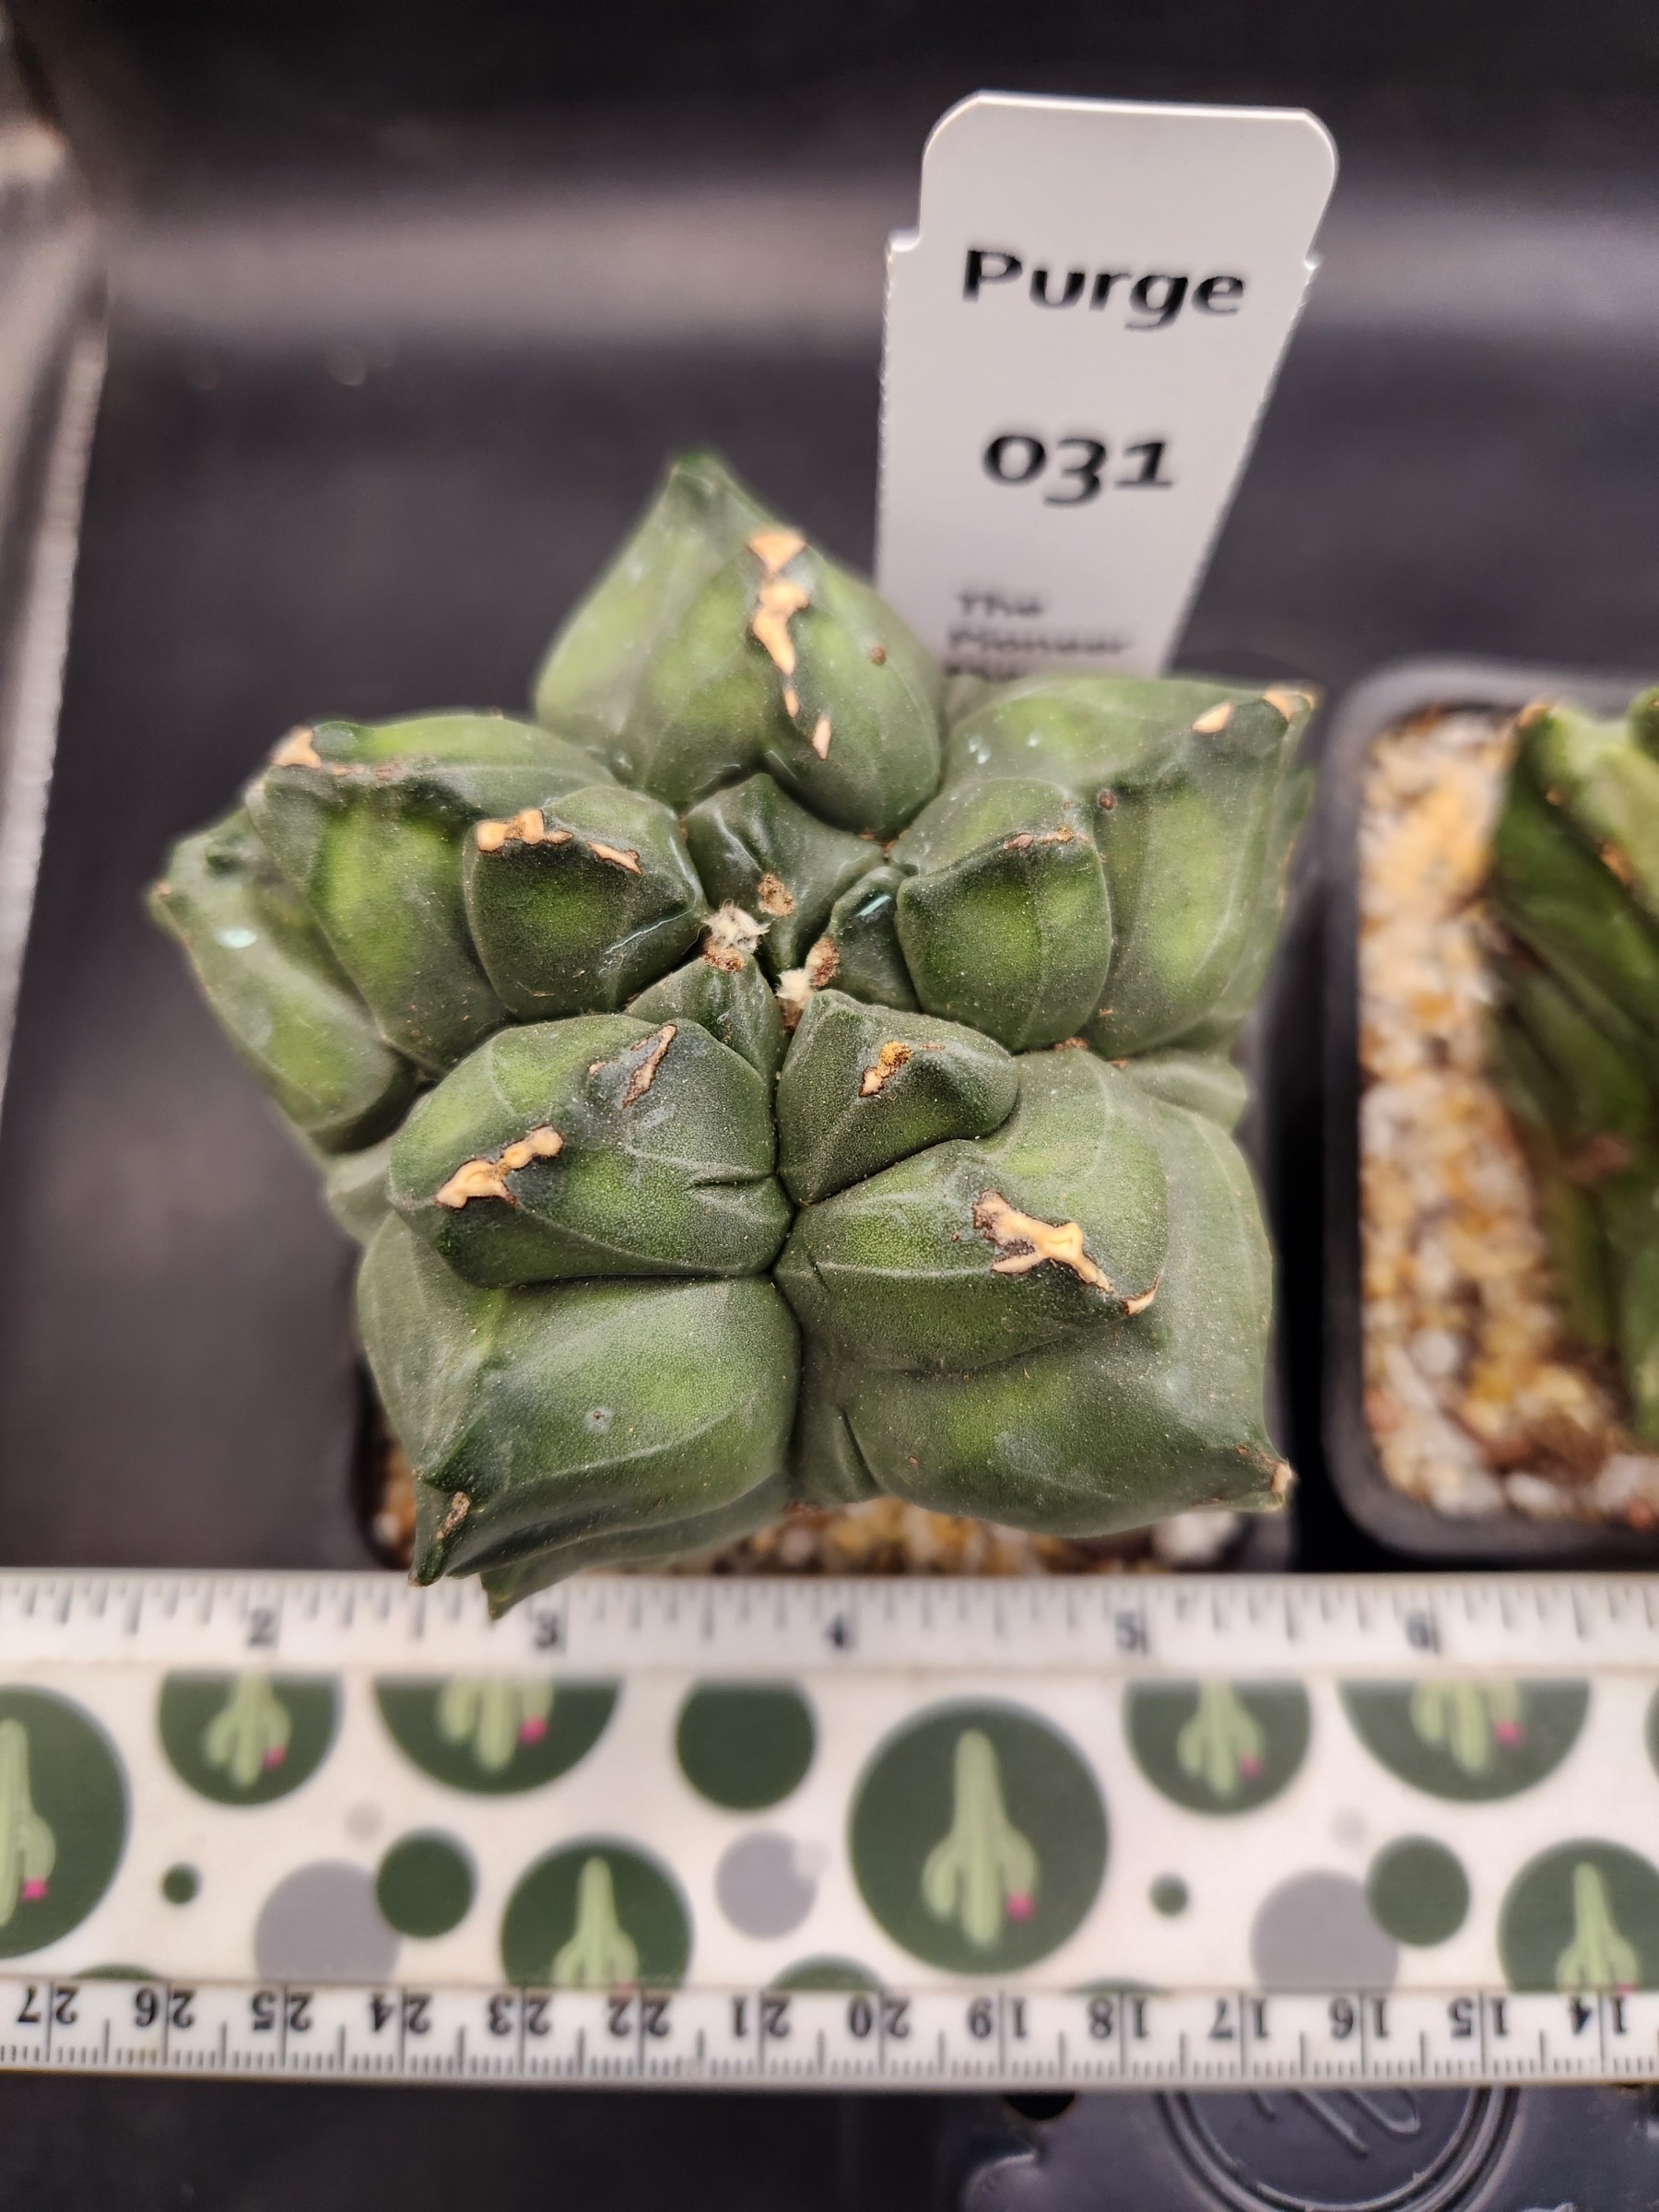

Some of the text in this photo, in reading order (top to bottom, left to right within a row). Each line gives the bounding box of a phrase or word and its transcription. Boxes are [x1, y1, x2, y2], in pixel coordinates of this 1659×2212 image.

[961, 249, 1246, 330] Purge
[982, 433, 1174, 508] 031
[248, 1607, 275, 1647] 2
[534, 1610, 559, 1650] 3
[1114, 1611, 1141, 1652] 5
[17, 1985, 1627, 2040] 14 15 16 17 18 19 20 21 22 23 24 25 26 27
